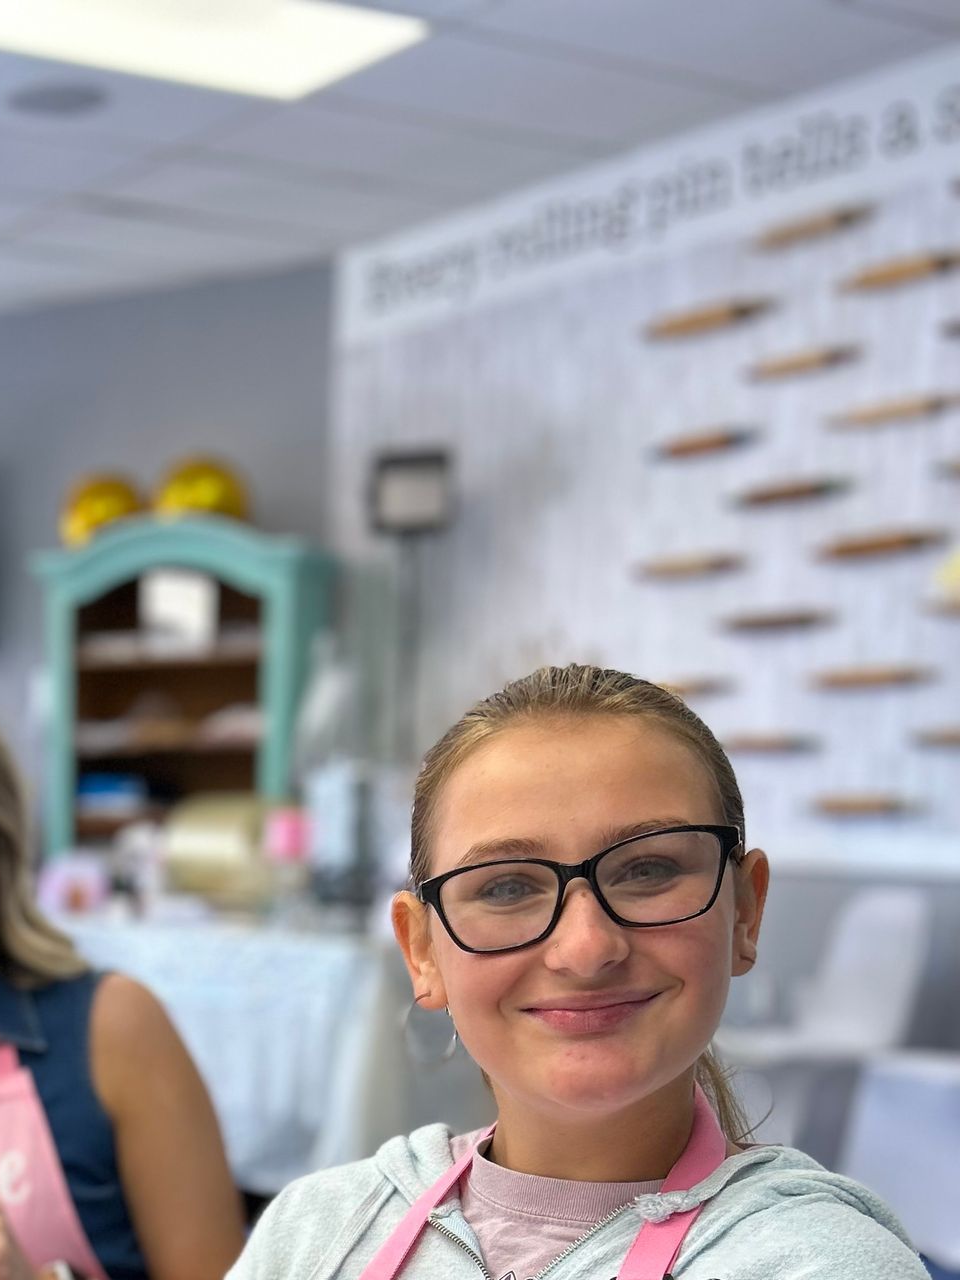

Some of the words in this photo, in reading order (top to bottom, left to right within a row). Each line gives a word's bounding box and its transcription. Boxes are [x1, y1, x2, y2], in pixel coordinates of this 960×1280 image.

[492, 180, 637, 281] rolling
[642, 155, 735, 239] pin
[742, 110, 872, 196] tells
[878, 99, 920, 161] a
